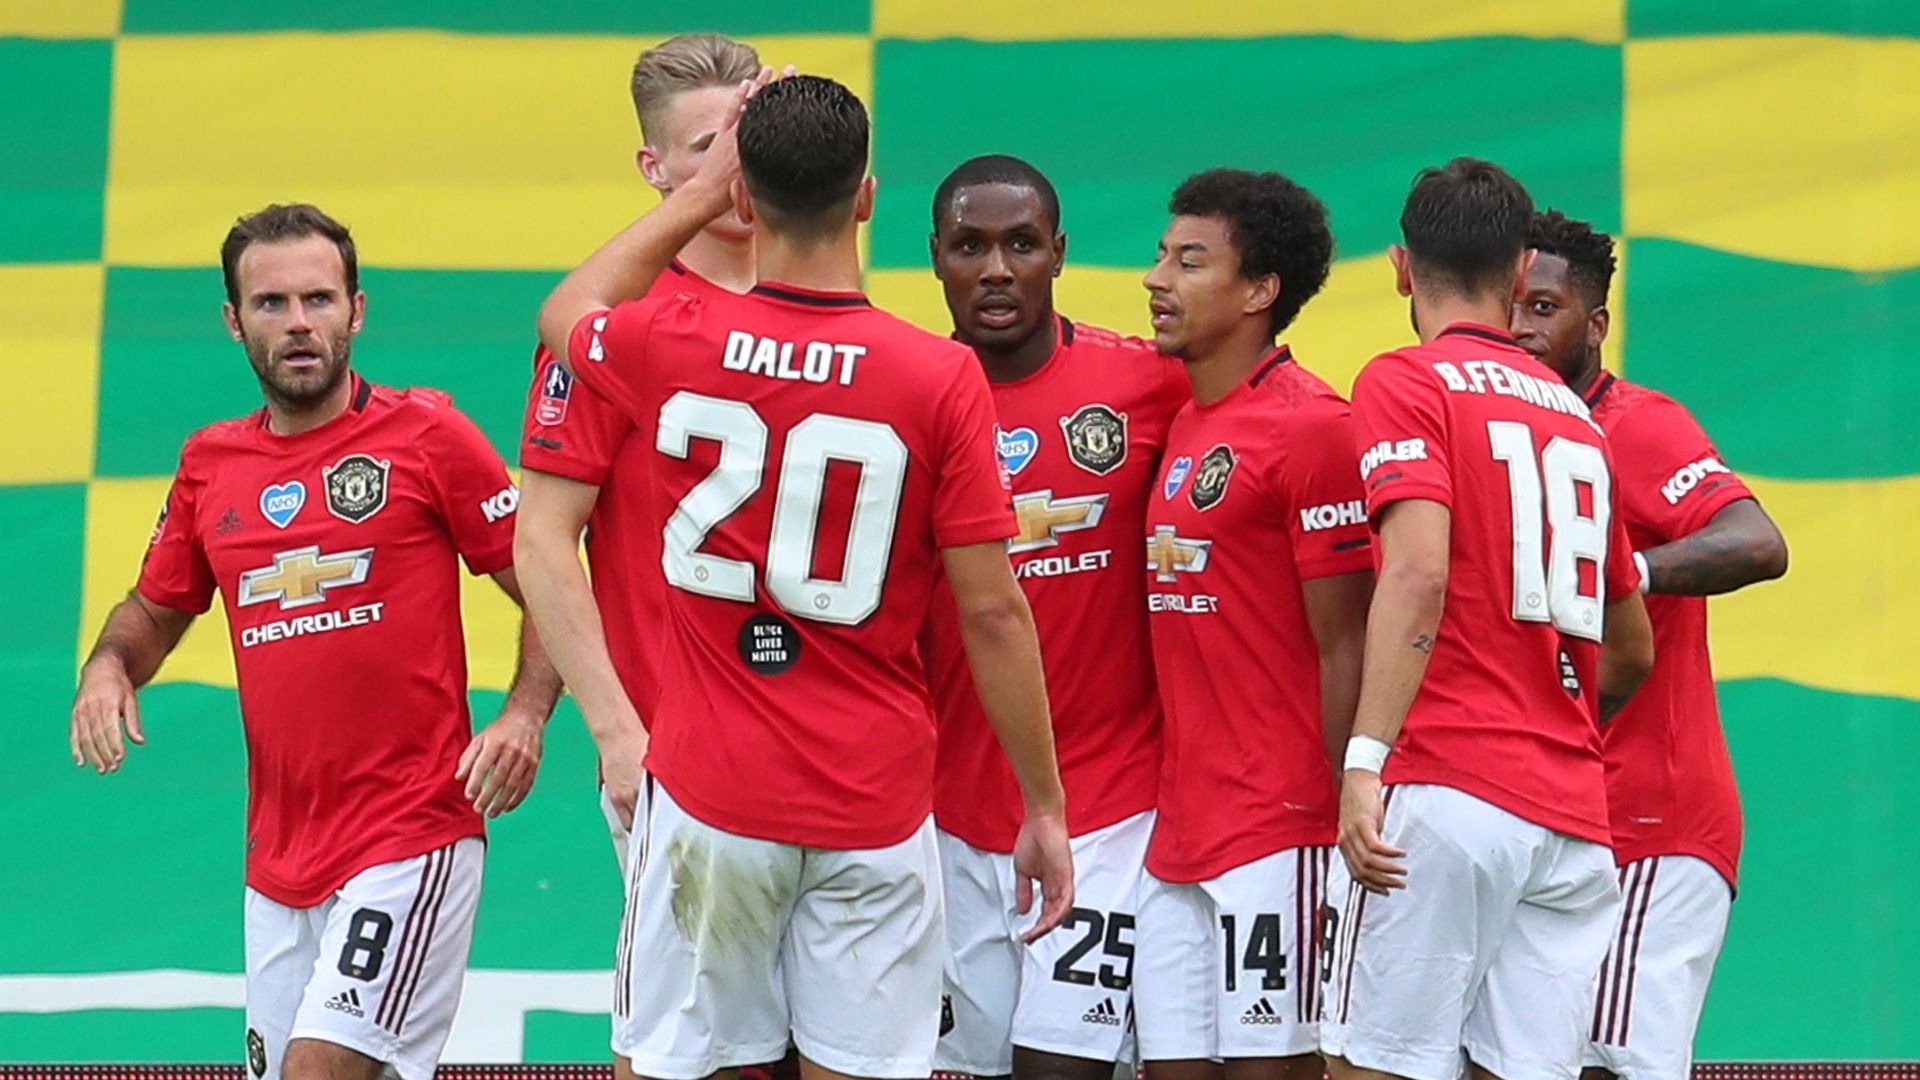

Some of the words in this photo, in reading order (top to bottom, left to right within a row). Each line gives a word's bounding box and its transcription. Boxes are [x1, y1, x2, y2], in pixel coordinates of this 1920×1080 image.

[723, 331, 867, 386] DALOT
[1360, 438, 1428, 481] OHLER
[269, 494, 296, 511] NHS
[656, 390, 909, 626] 20
[1300, 500, 1368, 532] KOHL
[1487, 421, 1612, 644] 18
[242, 602, 384, 647] CHEVROLET
[755, 637, 783, 649] LIVES
[751, 650, 788, 662] MATTER
[337, 908, 394, 982] 8
[1052, 907, 1135, 991] 25
[1220, 914, 1286, 992] 14
[324, 1000, 365, 1018] adidas
[1082, 1013, 1121, 1026] adidas
[1240, 1014, 1282, 1025] adidas
